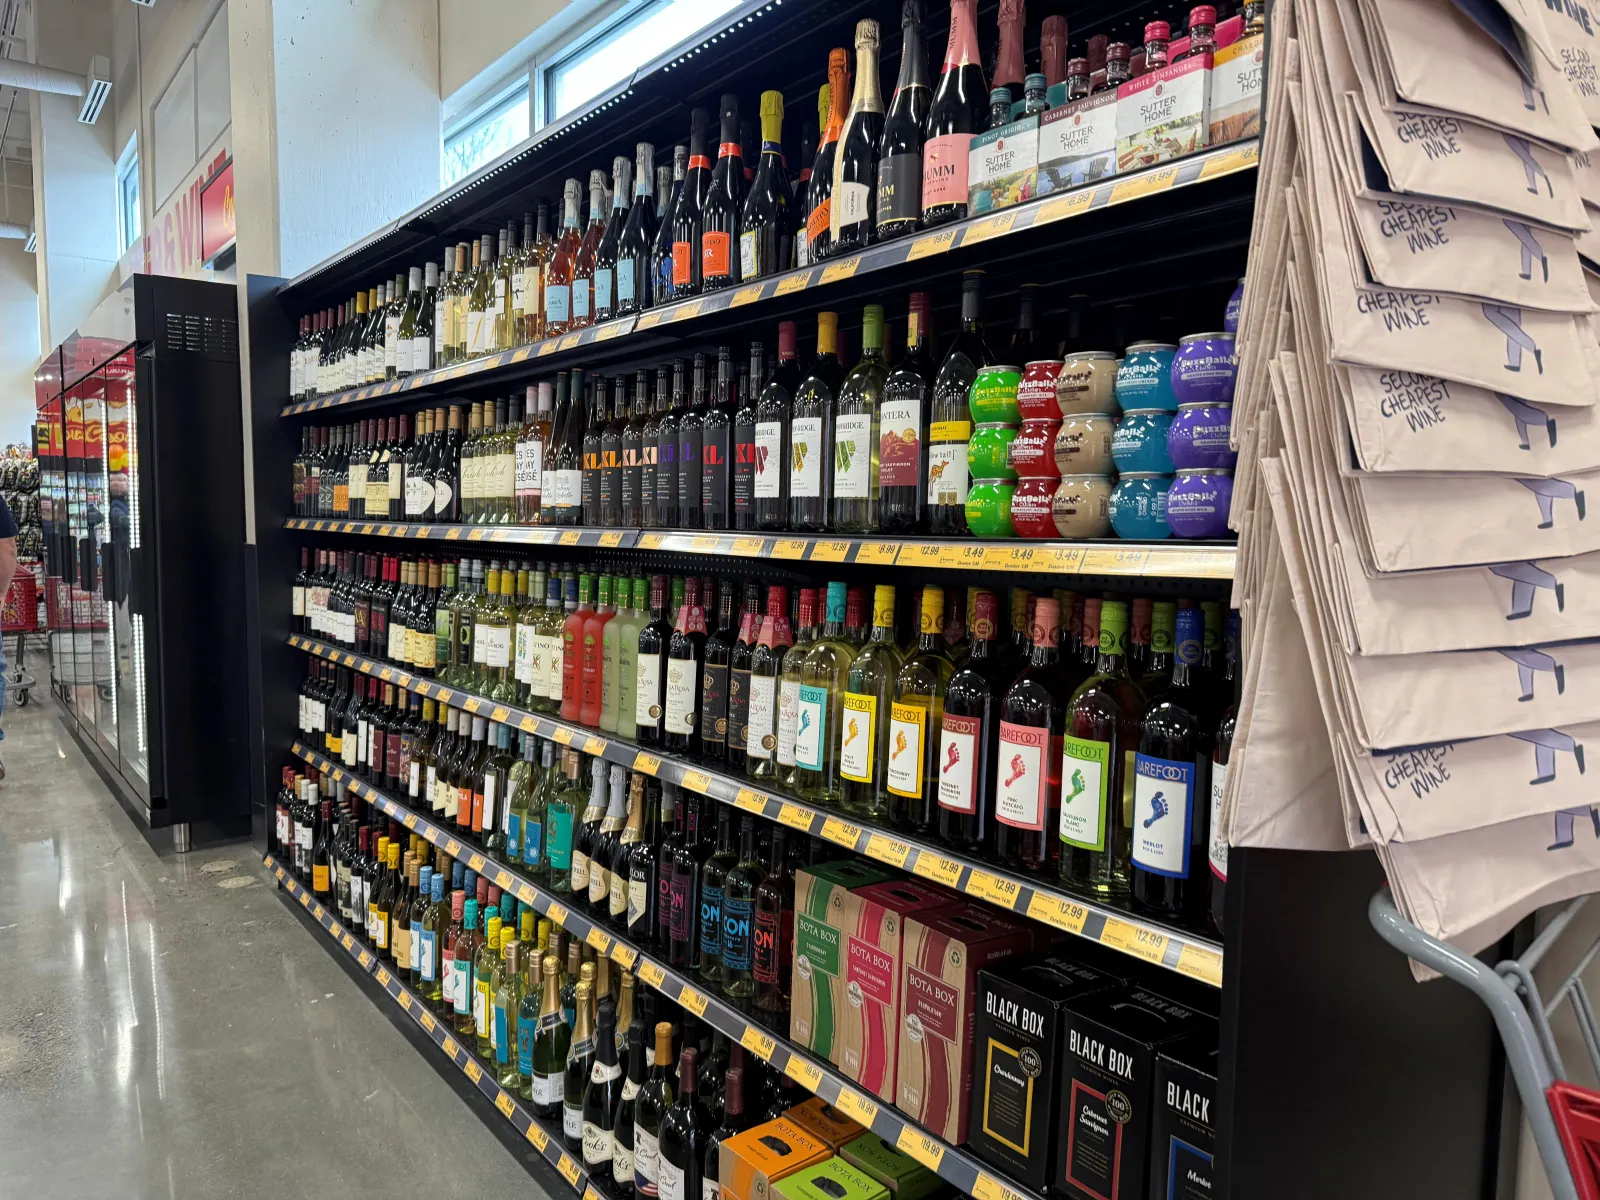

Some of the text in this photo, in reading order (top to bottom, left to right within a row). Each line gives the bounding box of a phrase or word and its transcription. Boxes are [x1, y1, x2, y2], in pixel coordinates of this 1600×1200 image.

[1044, 106, 1075, 122] CABERNET
[1140, 95, 1177, 116] SUTTER
[1144, 107, 1172, 123] HOME
[1060, 126, 1094, 142] SUTTER
[1063, 137, 1089, 150] HOME
[985, 151, 1015, 167] SUTTER
[1421, 136, 1462, 161] WINE
[988, 161, 1011, 174] HOME
[1406, 226, 1449, 254] WINE
[1383, 307, 1430, 333] WINE
[1380, 380, 1450, 418] CHEAPEST
[1406, 404, 1446, 433] WINE
[601, 450, 622, 468] XL
[1410, 762, 1451, 800] WINE
[799, 919, 837, 945] BOTA BOX
[851, 943, 891, 973] BOTA BOX
[909, 972, 955, 1008] BOTA BOX
[986, 991, 1045, 1038] BLACK BOX
[1024, 1054, 1036, 1067] 100
[1069, 1028, 1105, 1067] BLACK
[1108, 1047, 1134, 1080] BOX
[1082, 1104, 1108, 1125] Cabernet
[1111, 1097, 1125, 1112] 100
[1166, 1080, 1210, 1123] BLACK
[775, 1121, 817, 1151] BOTA BOX
[829, 1161, 873, 1192] BOTA BOX
